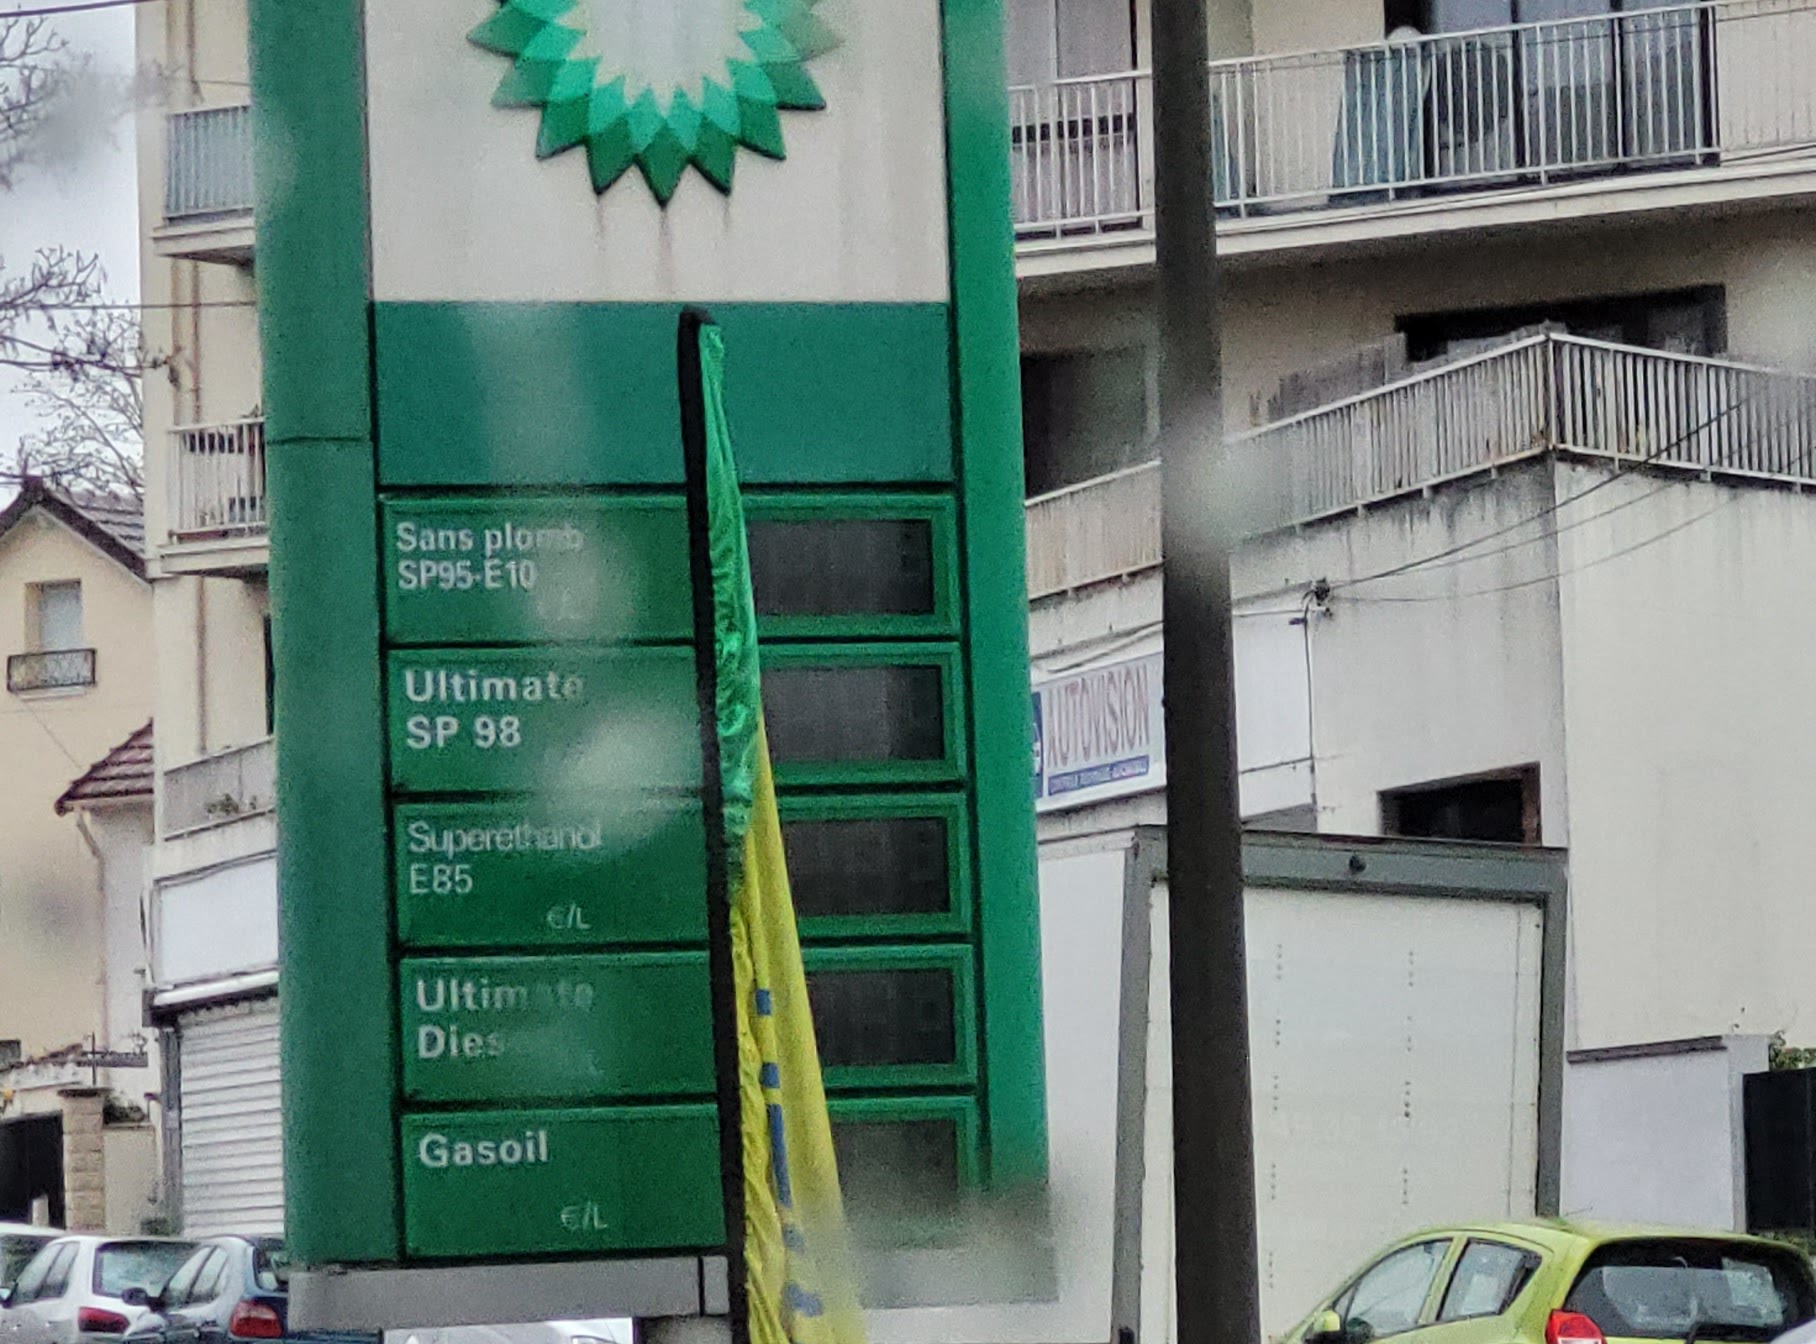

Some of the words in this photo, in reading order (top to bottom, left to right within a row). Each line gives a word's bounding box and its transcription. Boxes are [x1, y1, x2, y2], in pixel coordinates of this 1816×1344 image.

[396, 521, 474, 552] Sans
[399, 558, 538, 590] SP95-E10
[405, 669, 584, 703] Ultimate
[406, 714, 460, 749] SP
[474, 714, 522, 748] 98
[1048, 663, 1150, 767] AUTOVISION
[409, 863, 474, 894] E85
[416, 978, 594, 1012] Ultimte
[418, 1024, 504, 1059] Dies
[419, 1130, 549, 1168] Gasoil
